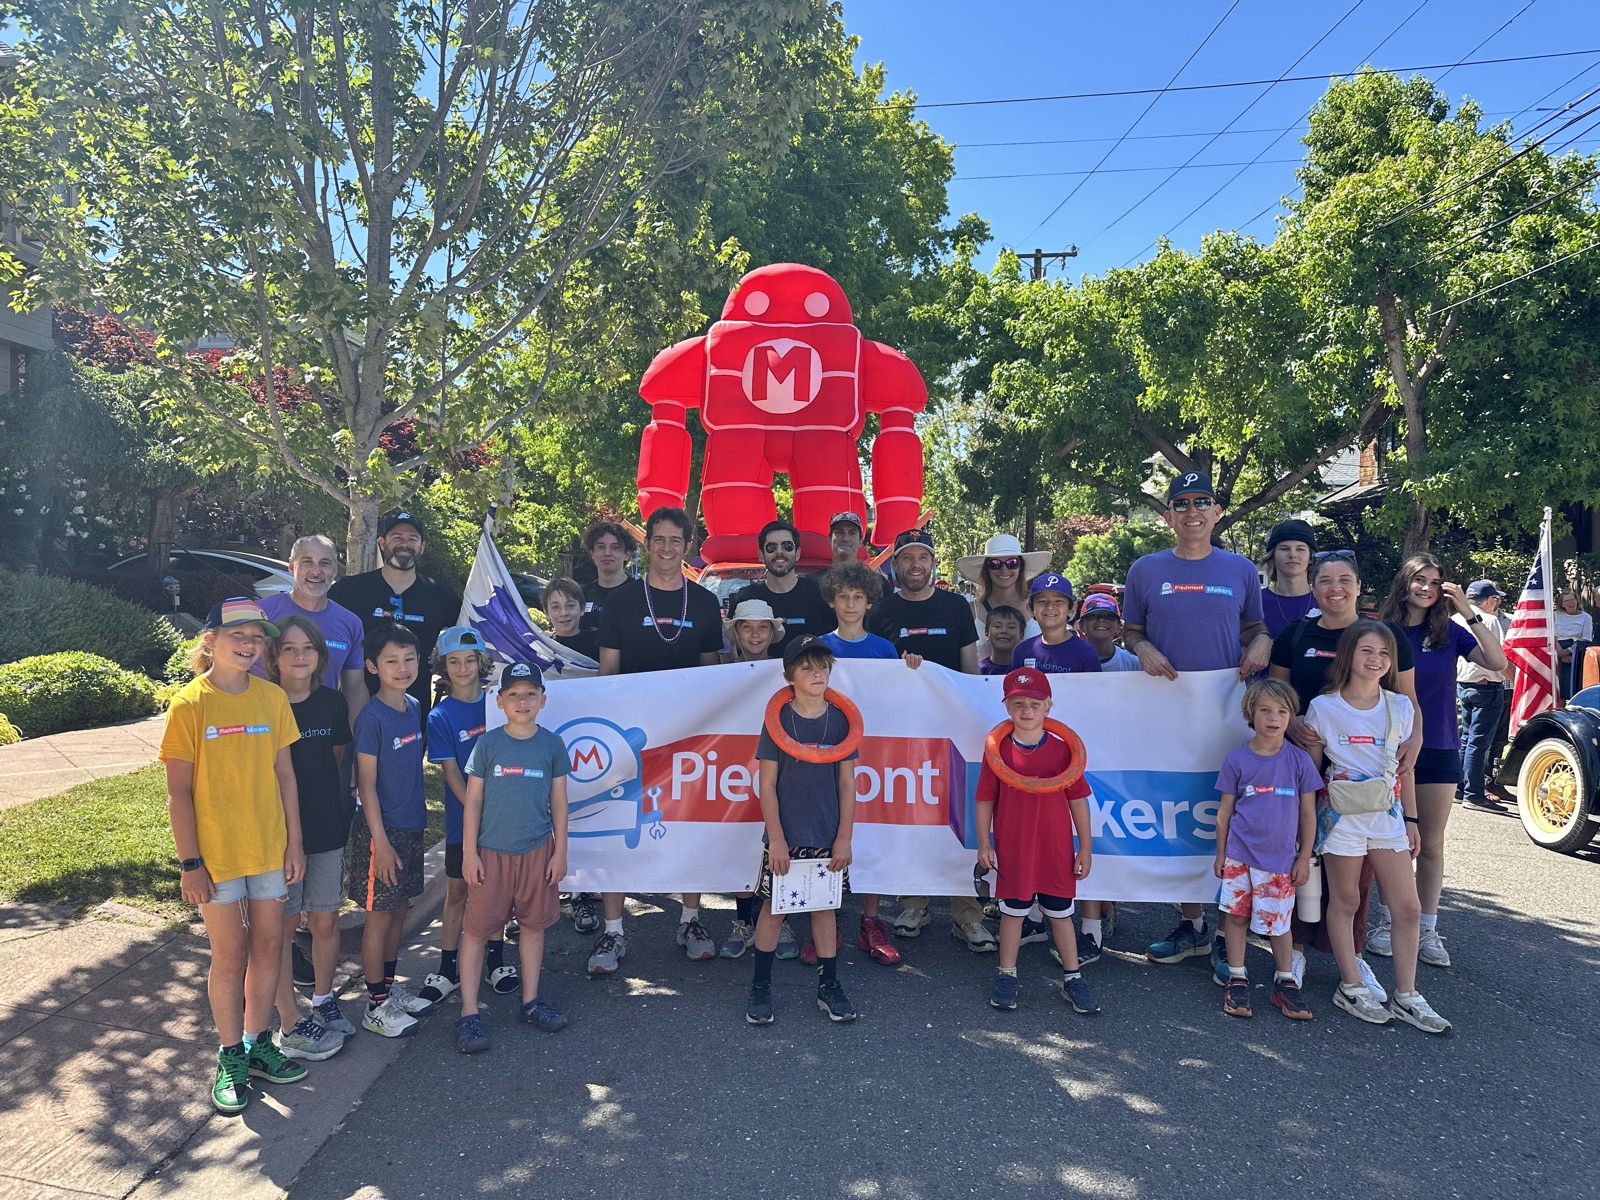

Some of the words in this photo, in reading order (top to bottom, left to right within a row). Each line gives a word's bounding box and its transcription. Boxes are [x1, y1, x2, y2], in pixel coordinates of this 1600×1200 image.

[752, 346, 811, 402] M
[1207, 586, 1232, 595] Makers
[219, 726, 245, 735] Piedmont
[572, 744, 603, 772] M
[671, 750, 939, 805] Pieont
